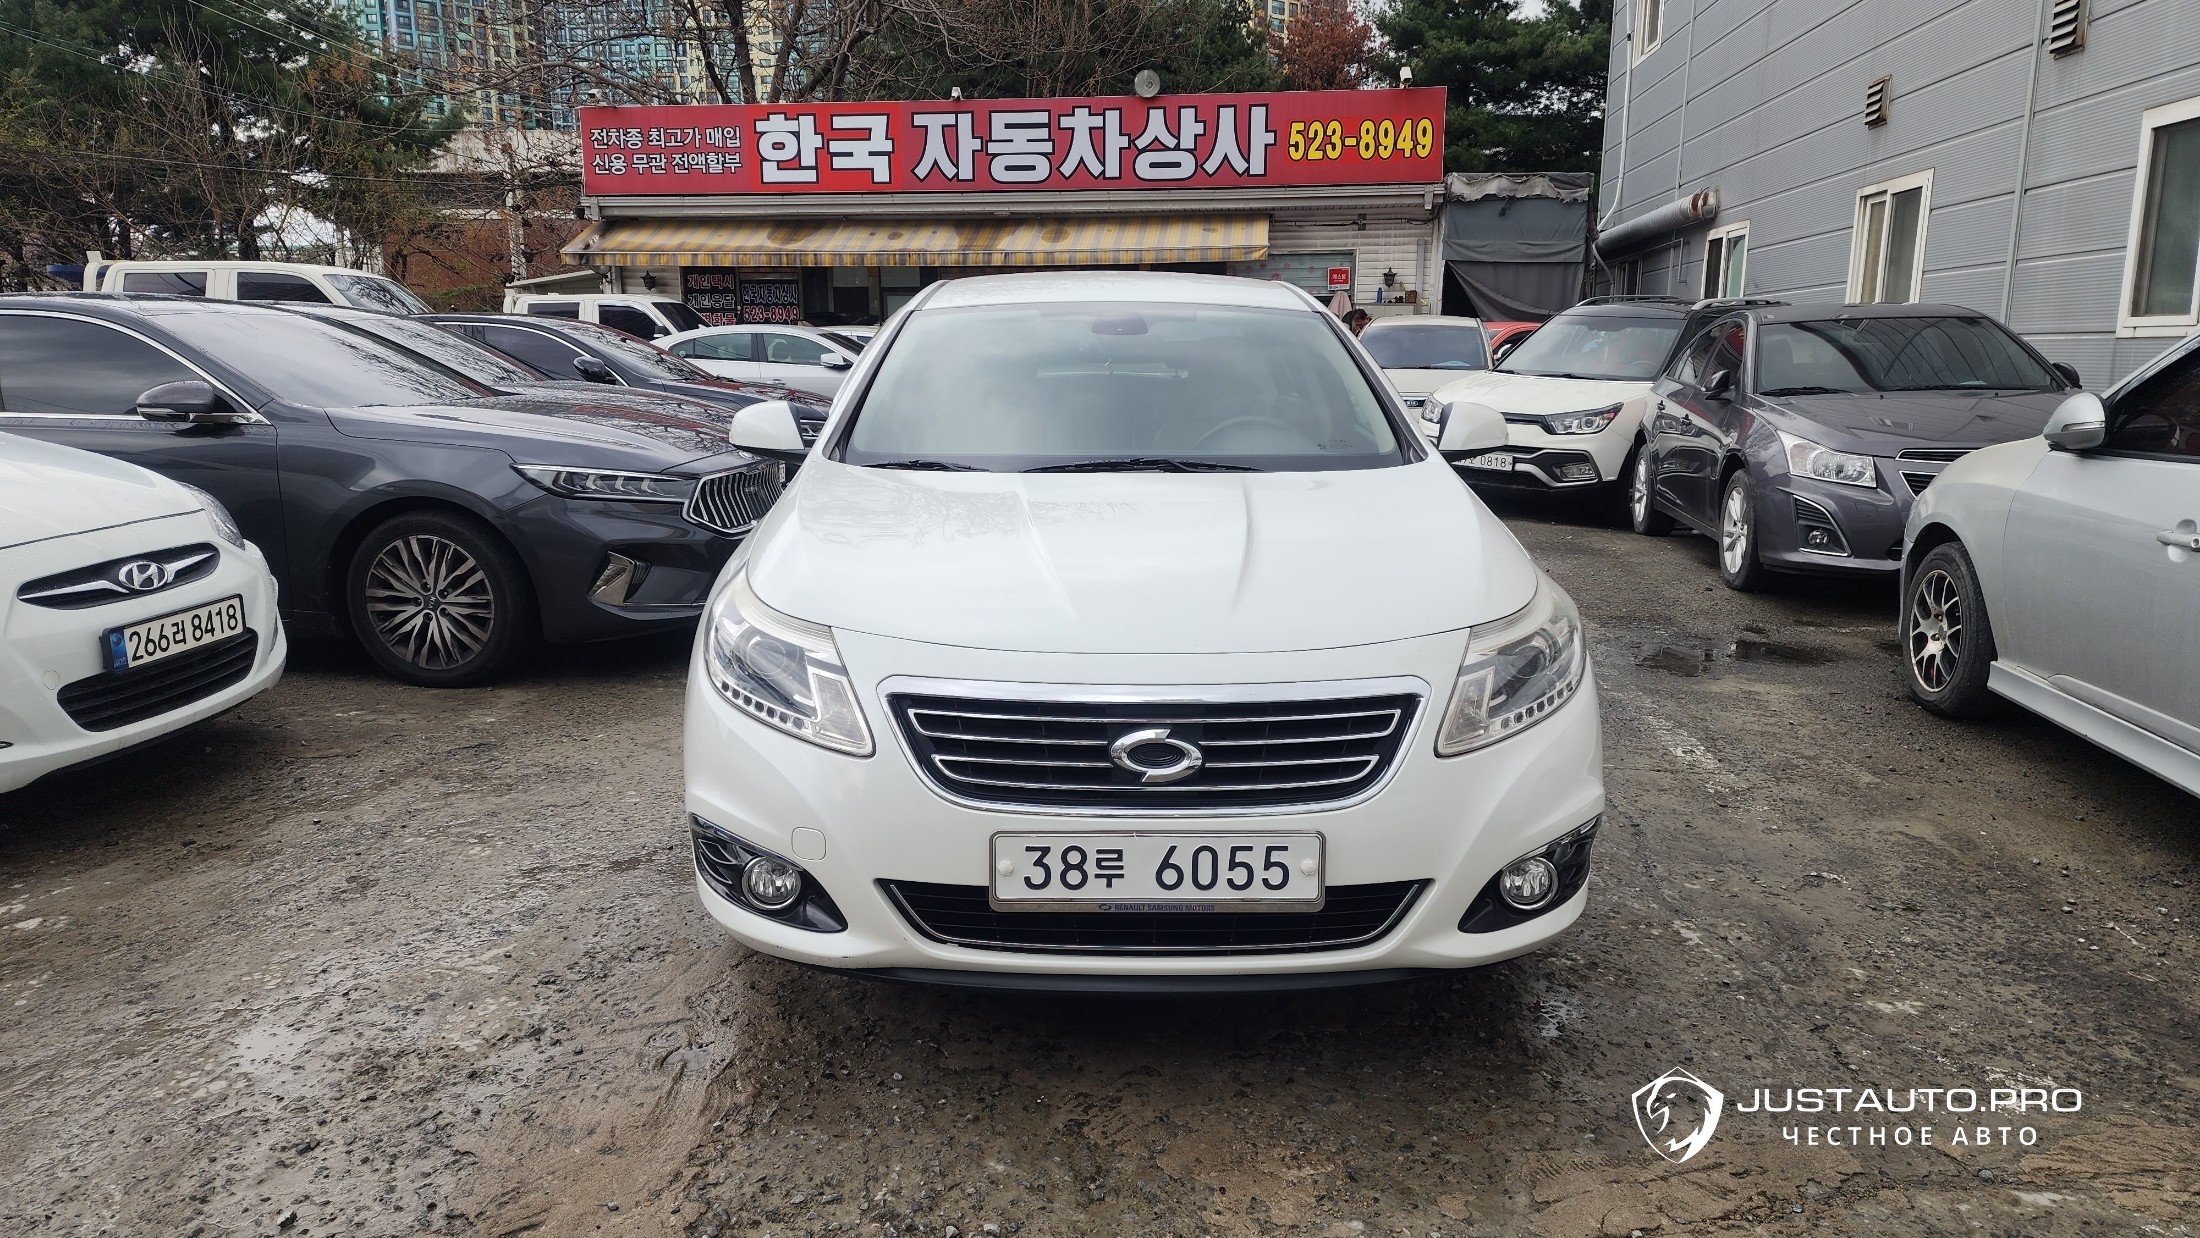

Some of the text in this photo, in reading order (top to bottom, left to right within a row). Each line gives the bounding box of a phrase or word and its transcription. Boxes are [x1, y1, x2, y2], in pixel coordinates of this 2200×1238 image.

[590, 126, 741, 149] 전차종 최고가 매입
[754, 104, 1276, 183] 한국 자동차상사
[1288, 118, 1434, 161] 523-8949
[592, 152, 742, 175] 신용 무관 전액할부
[687, 274, 734, 289] 개인택시
[687, 293, 735, 308] 개인용달
[742, 284, 798, 304] 한국자동차상사
[743, 306, 799, 322] 523-8949
[128, 603, 238, 662] 266러 8418
[1023, 845, 1290, 890] 38루 6055
[1114, 904, 1216, 912] RENAULT SAMSUNG MOTORS
